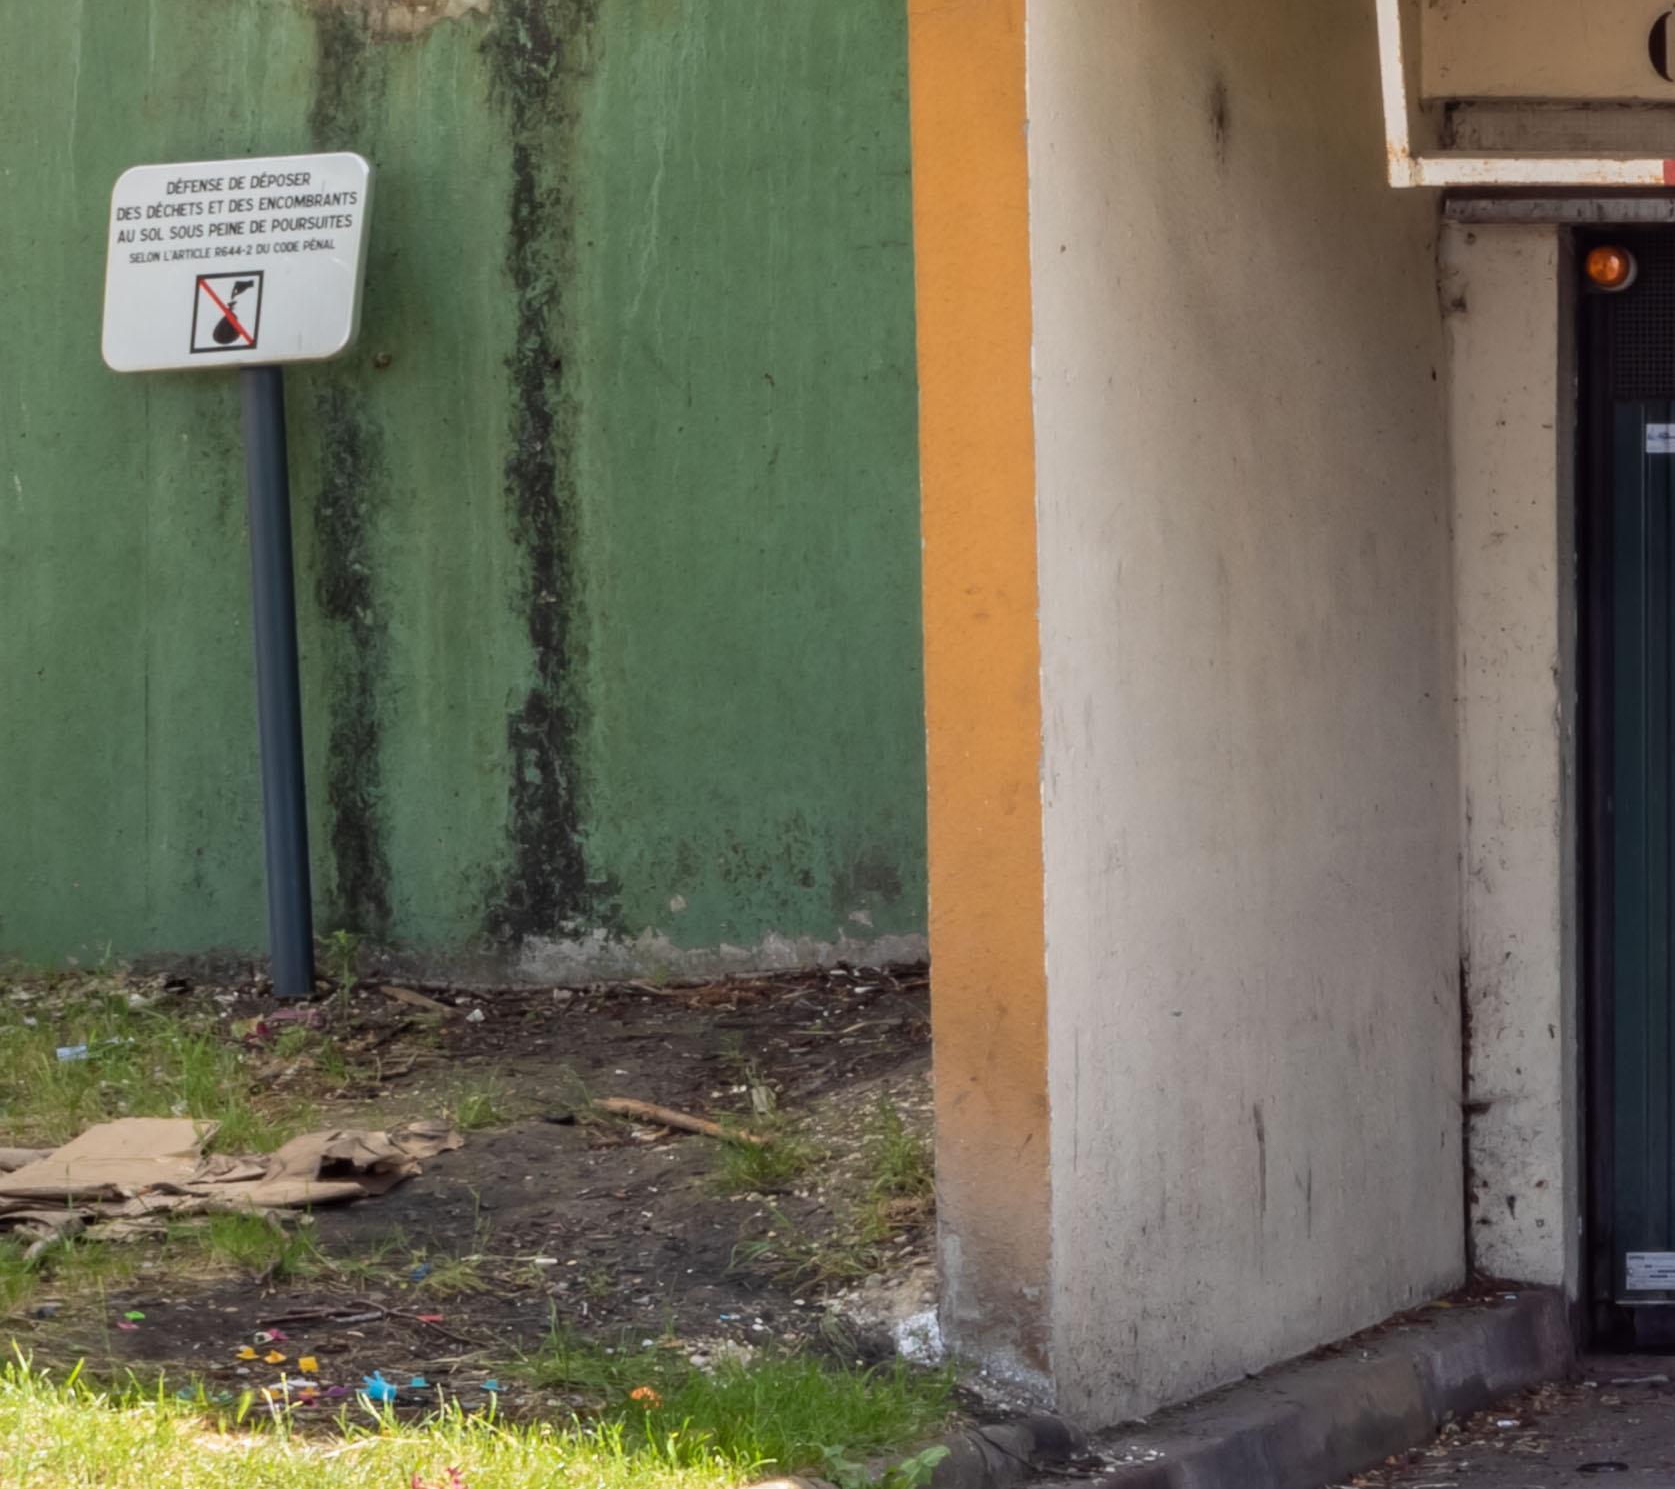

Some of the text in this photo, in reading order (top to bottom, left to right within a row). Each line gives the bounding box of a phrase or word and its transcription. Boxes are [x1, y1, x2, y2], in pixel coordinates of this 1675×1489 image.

[166, 171, 311, 195] DÉFENSE DE DÉPOSER
[116, 191, 358, 222] DES DÉCHETS ET DES ENCOMBRANTS
[117, 214, 353, 244] AU SOL SOUS PEINE DE POURSUITES
[129, 237, 336, 264] SELON L'ARTICLE R644-2 DU CODE PÉNAL
